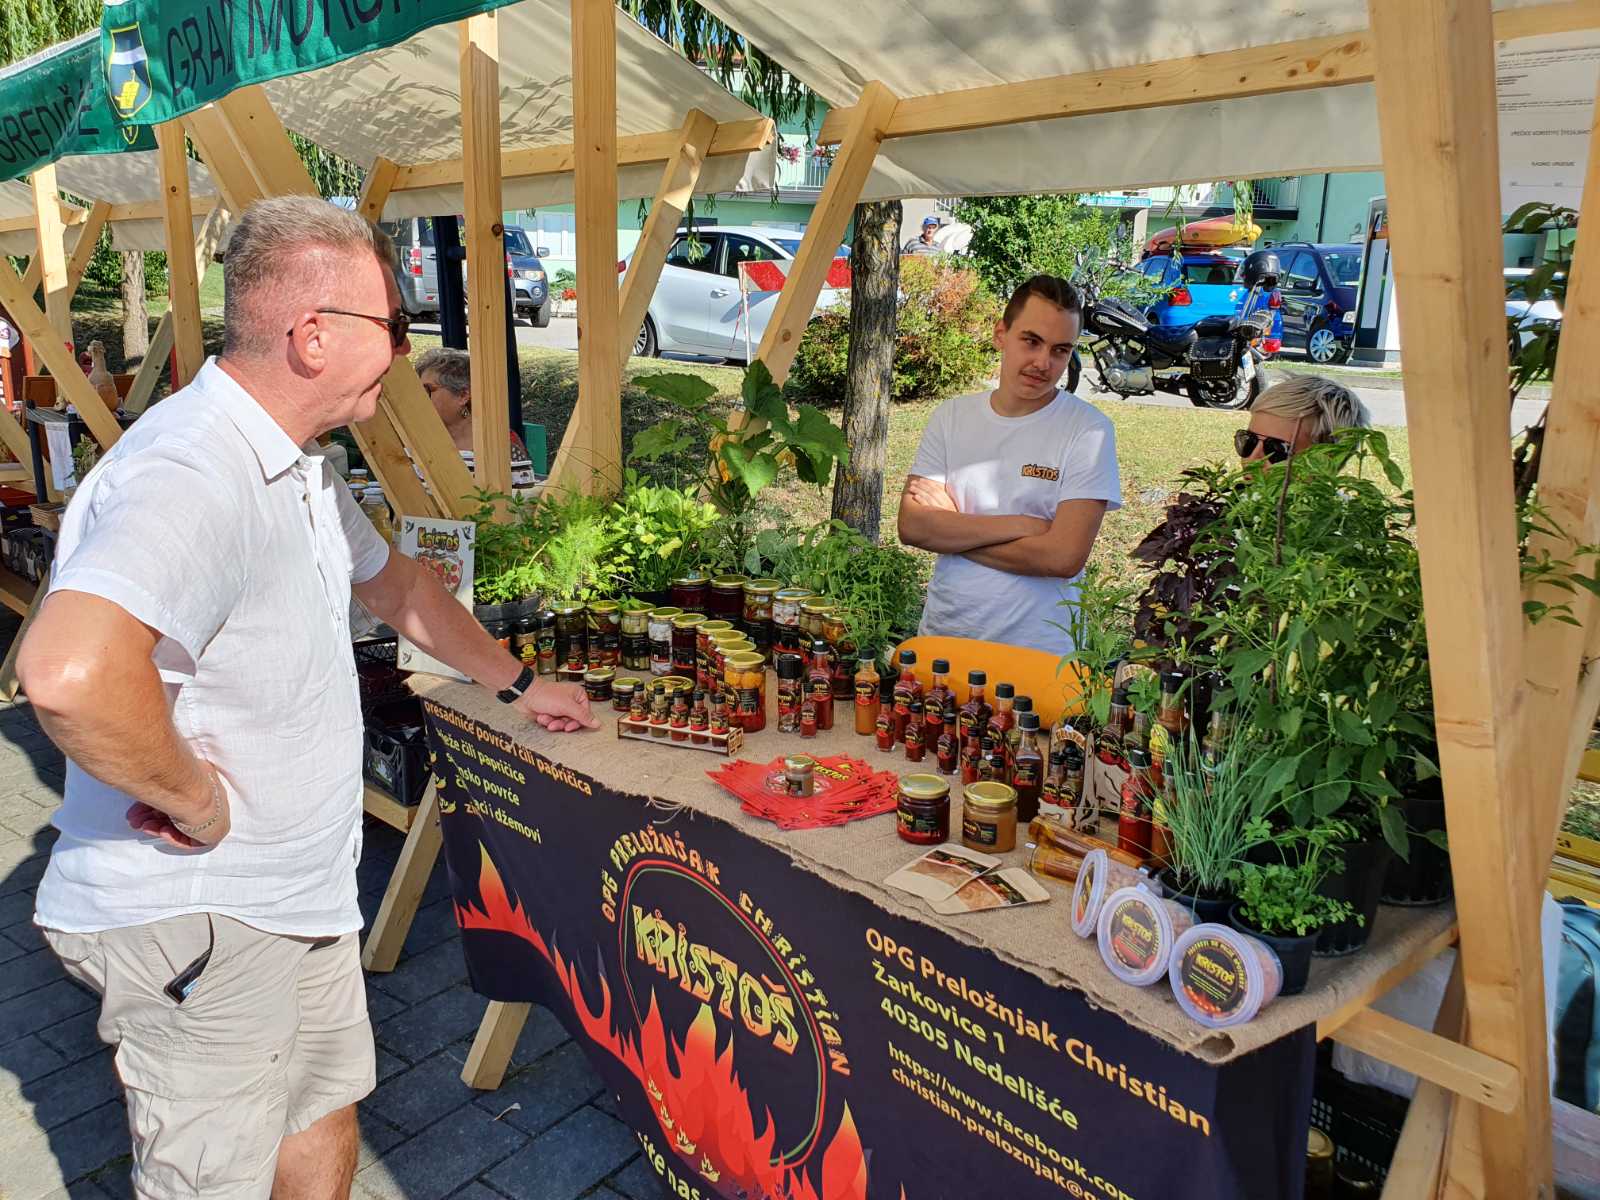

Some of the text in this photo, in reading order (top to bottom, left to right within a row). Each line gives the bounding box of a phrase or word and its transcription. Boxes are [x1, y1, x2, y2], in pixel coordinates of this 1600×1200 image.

[483, 778, 520, 806] povrće
[495, 808, 541, 844] džemovi
[865, 927, 1211, 1137] OPG Preložnjak Christian
[872, 959, 1006, 1054] Žarkovice 1
[880, 996, 1079, 1131] 40305 Nedelišće
